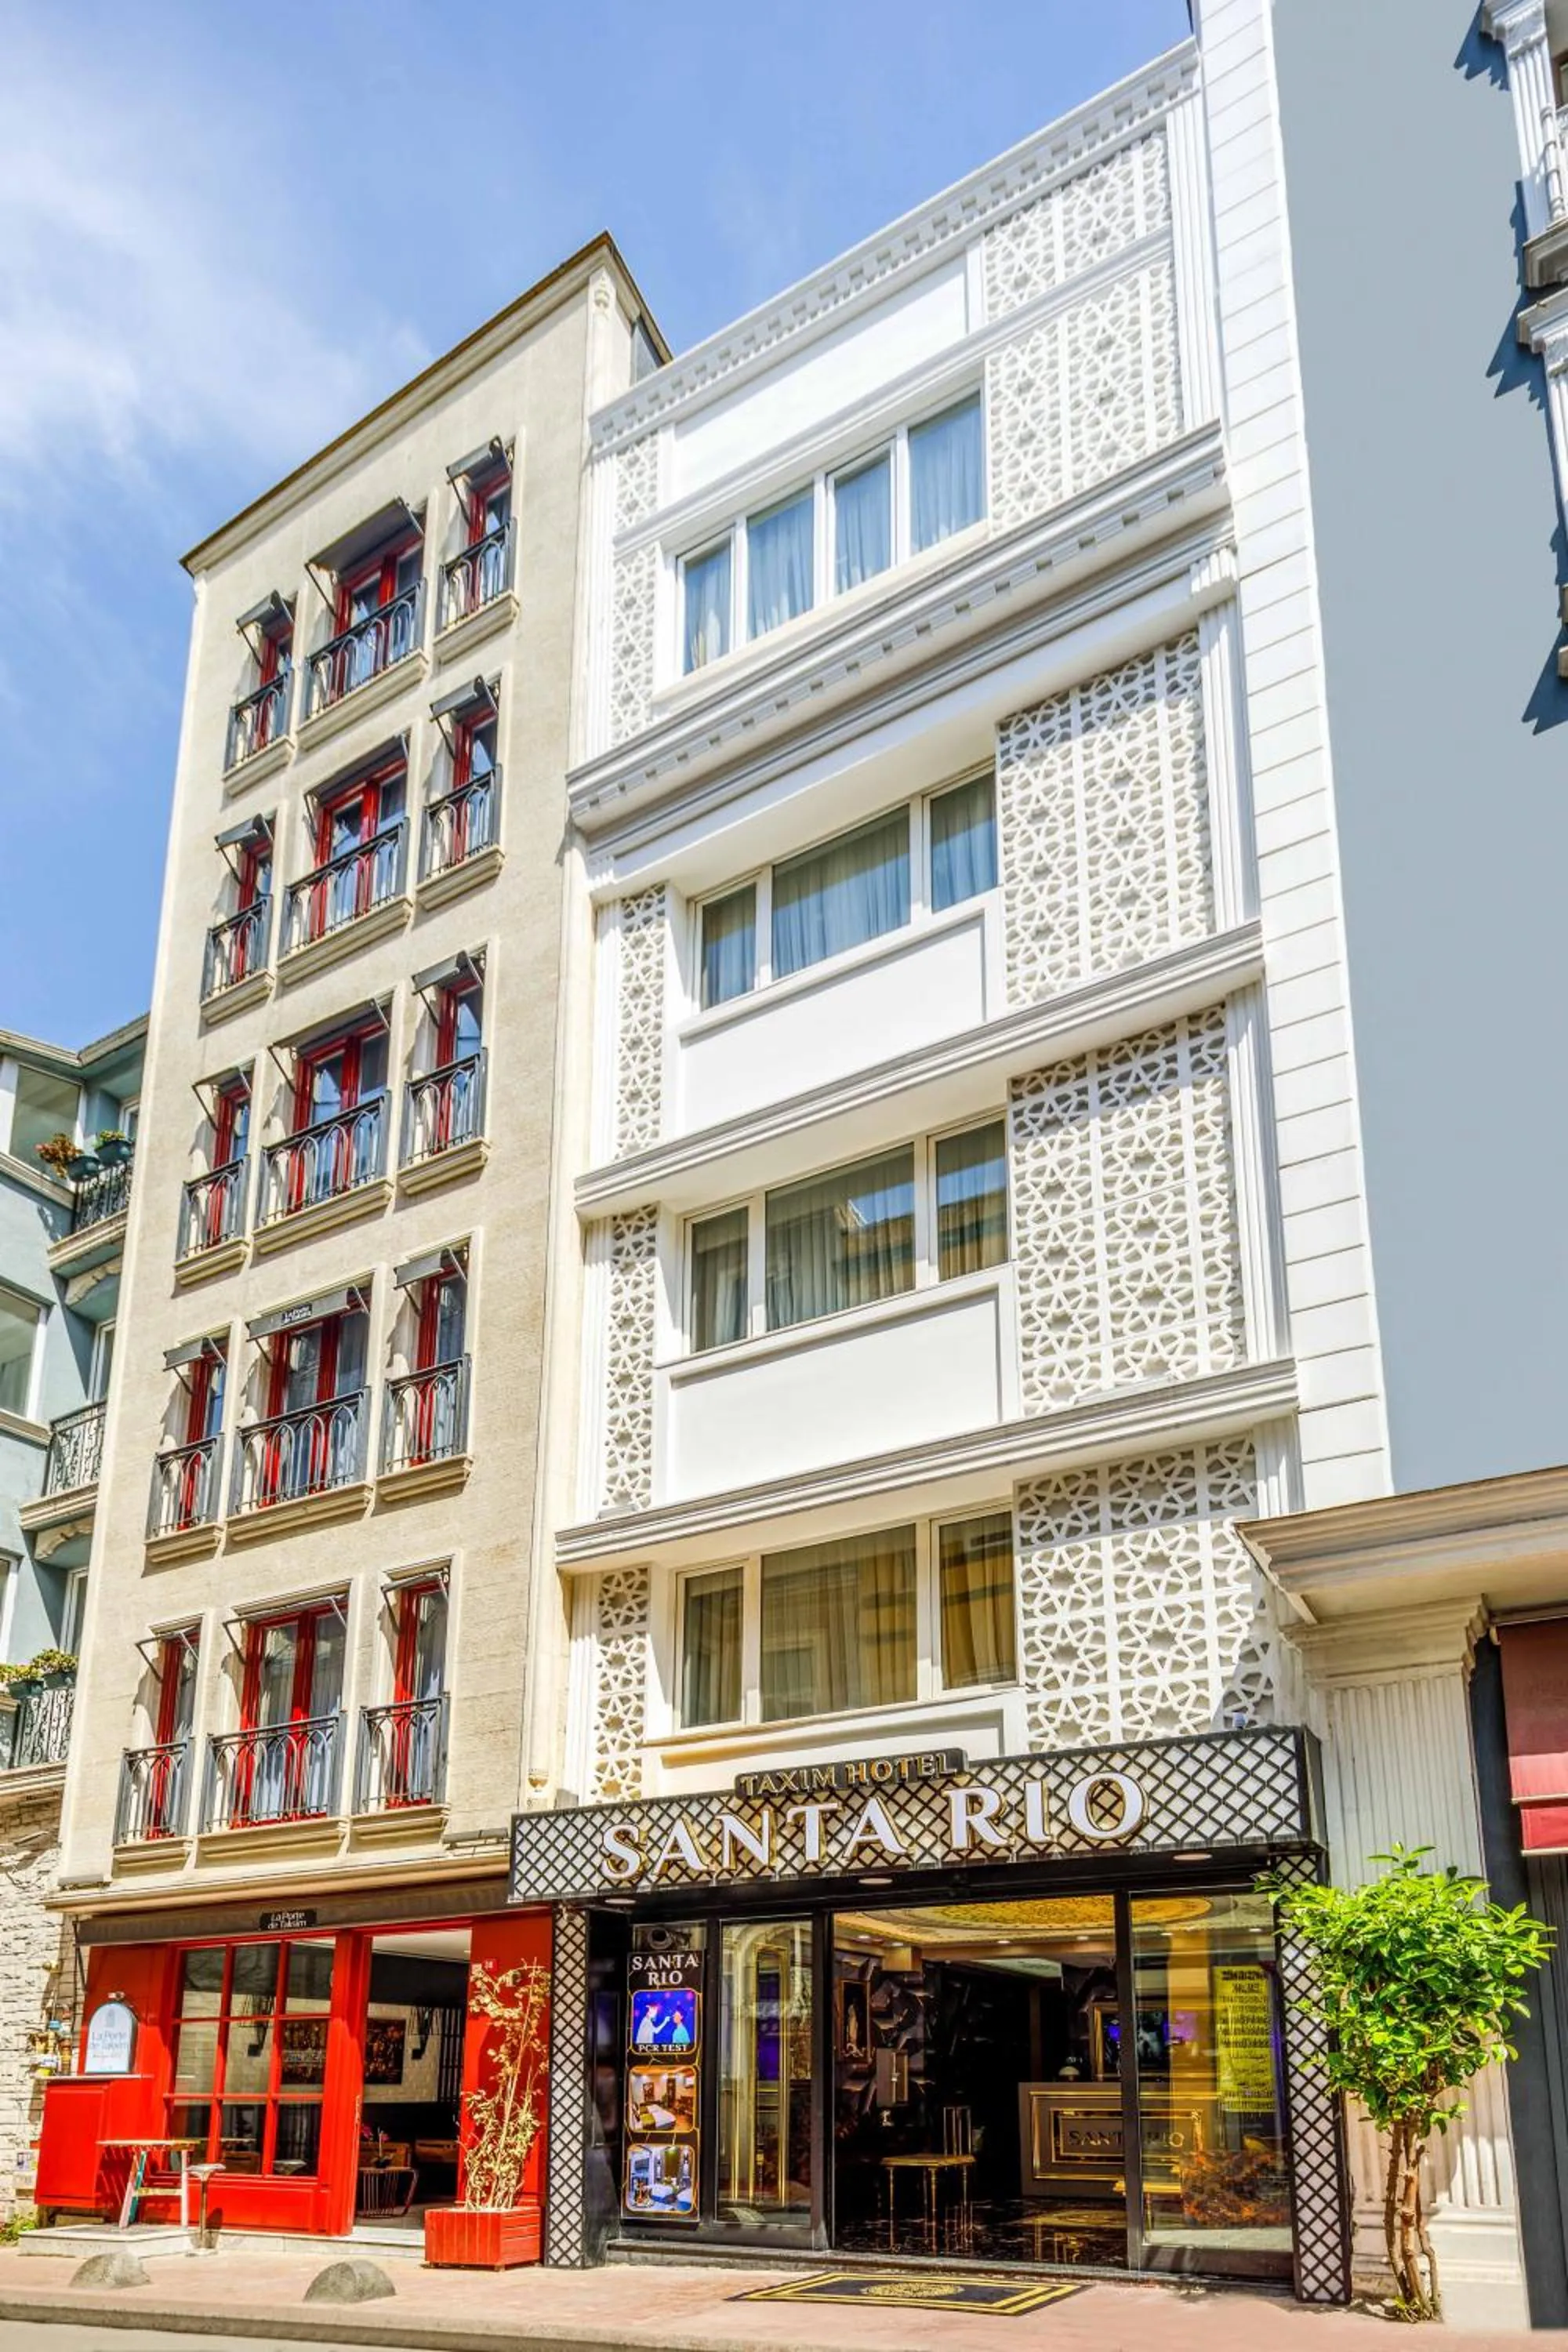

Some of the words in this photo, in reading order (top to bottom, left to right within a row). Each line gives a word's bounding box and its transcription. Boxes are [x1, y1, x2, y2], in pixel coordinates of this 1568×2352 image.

[739, 1766, 837, 1796] TAXIM
[845, 1752, 957, 1786] HOTEL
[600, 1796, 914, 1880] SANTA
[942, 1771, 1150, 1850] RIO
[632, 1953, 699, 1971] SANTA
[647, 1970, 683, 1986] RIO
[639, 2044, 659, 2053] PCR
[661, 2043, 688, 2053] TEST
[1068, 2130, 1123, 2147] SANT
